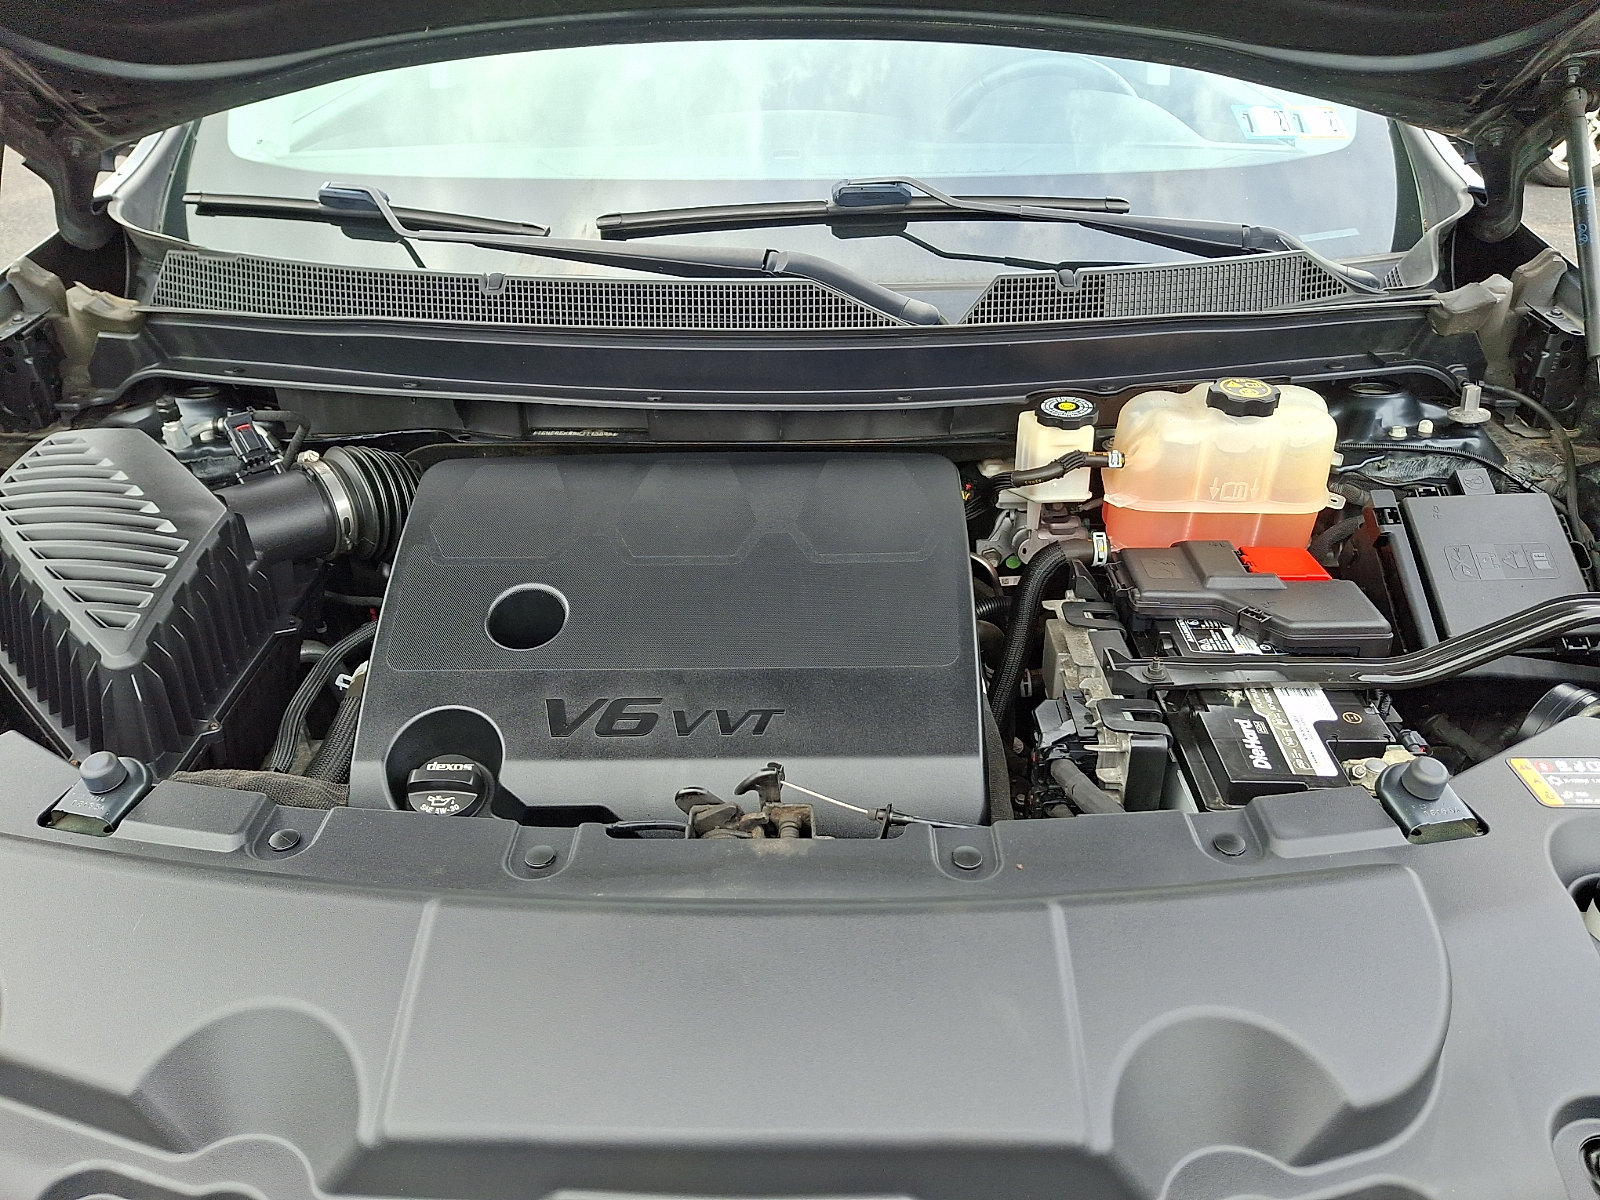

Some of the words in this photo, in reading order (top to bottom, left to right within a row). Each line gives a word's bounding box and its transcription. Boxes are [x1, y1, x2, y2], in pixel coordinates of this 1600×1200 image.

[546, 698, 663, 738] V6
[672, 708, 786, 737] VVT
[1233, 718, 1273, 770] DieHard
[426, 761, 475, 771] dexos
[420, 804, 434, 813] SAE
[435, 804, 460, 815] 5W-30
